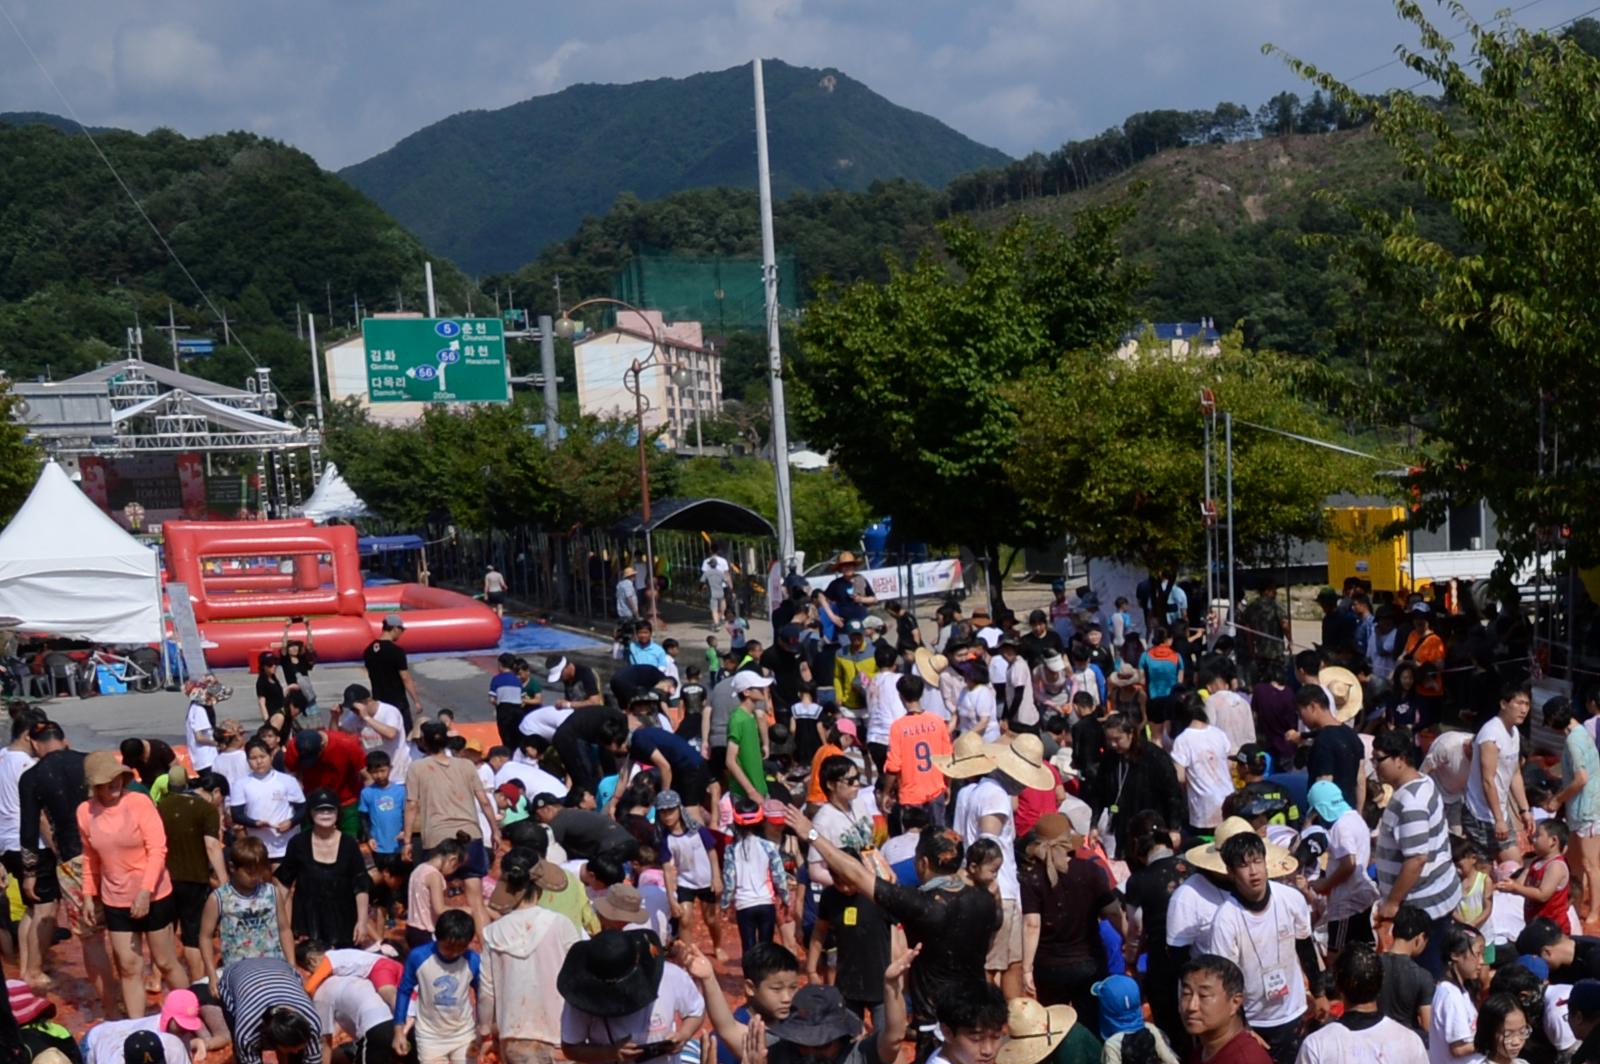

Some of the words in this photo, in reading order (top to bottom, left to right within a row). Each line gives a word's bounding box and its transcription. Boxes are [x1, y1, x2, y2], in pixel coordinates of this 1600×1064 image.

[443, 323, 452, 334] 5
[915, 741, 932, 772] 9
[432, 975, 459, 1006] 2
